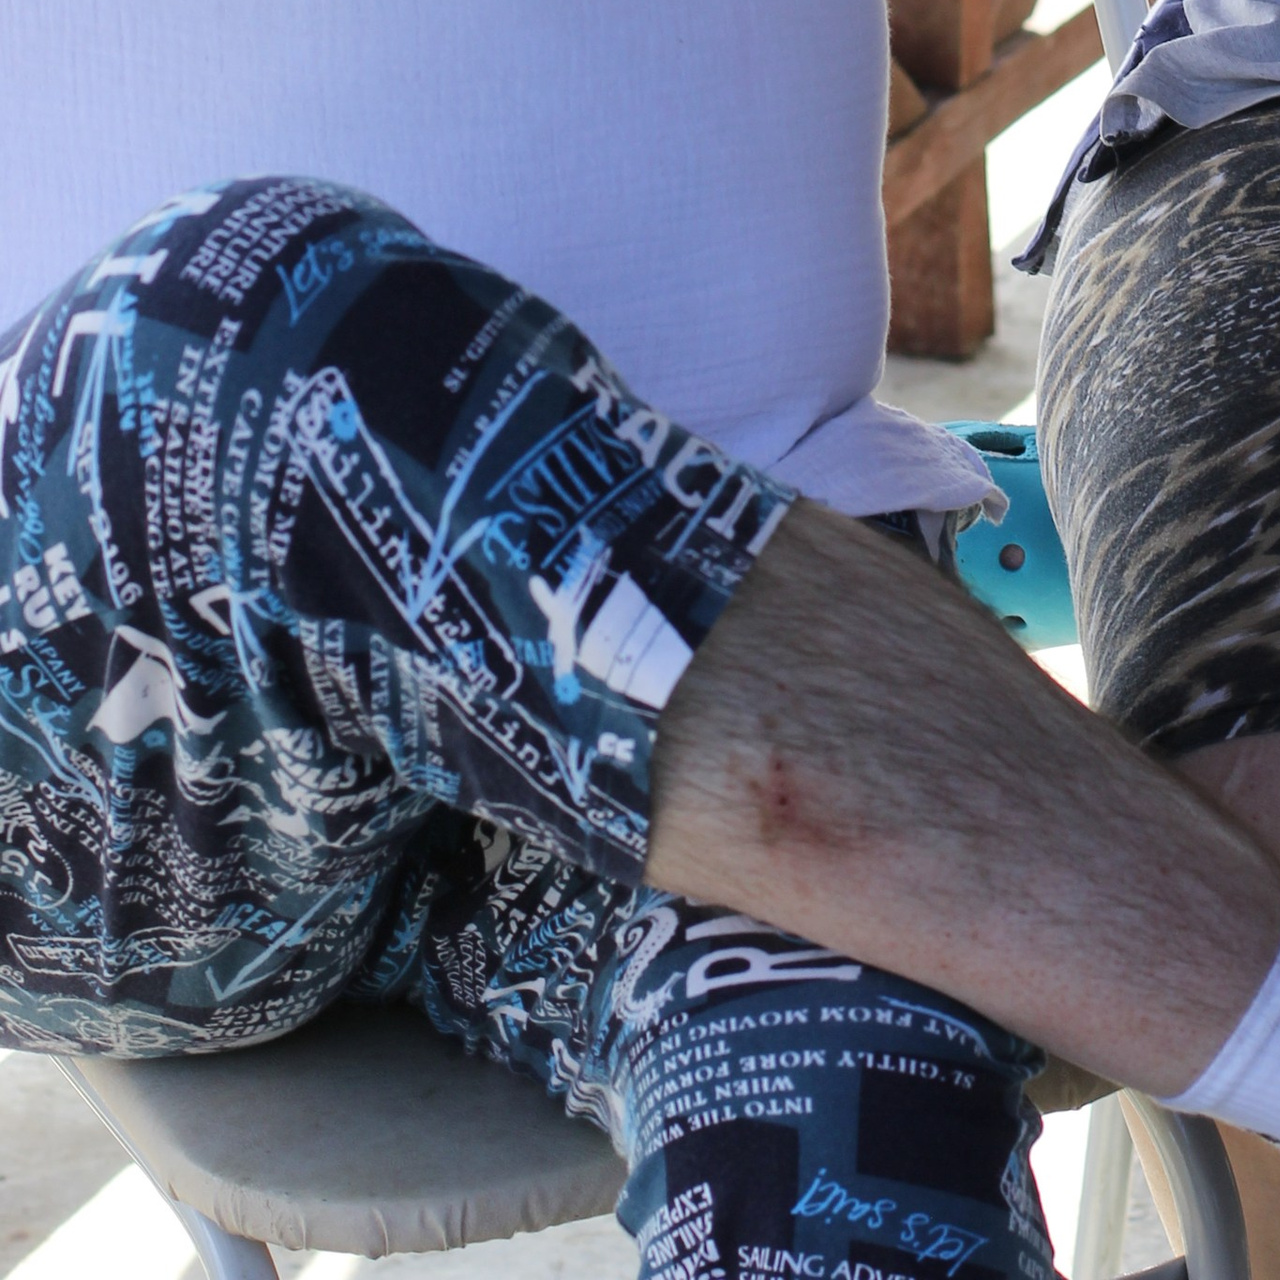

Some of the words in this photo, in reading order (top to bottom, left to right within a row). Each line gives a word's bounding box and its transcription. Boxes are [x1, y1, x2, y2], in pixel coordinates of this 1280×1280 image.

[43, 542, 92, 621] KEY
[688, 1007, 809, 1042] MOVING
[819, 1005, 910, 1028] FROM
[664, 1040, 731, 1074] THAN
[739, 1050, 827, 1071] MORE
[715, 1076, 795, 1101] WHEN
[664, 1090, 708, 1118] THE
[750, 1096, 814, 1116] INTO
[687, 1105, 737, 1131] THE
[737, 1245, 825, 1278] SAILING
